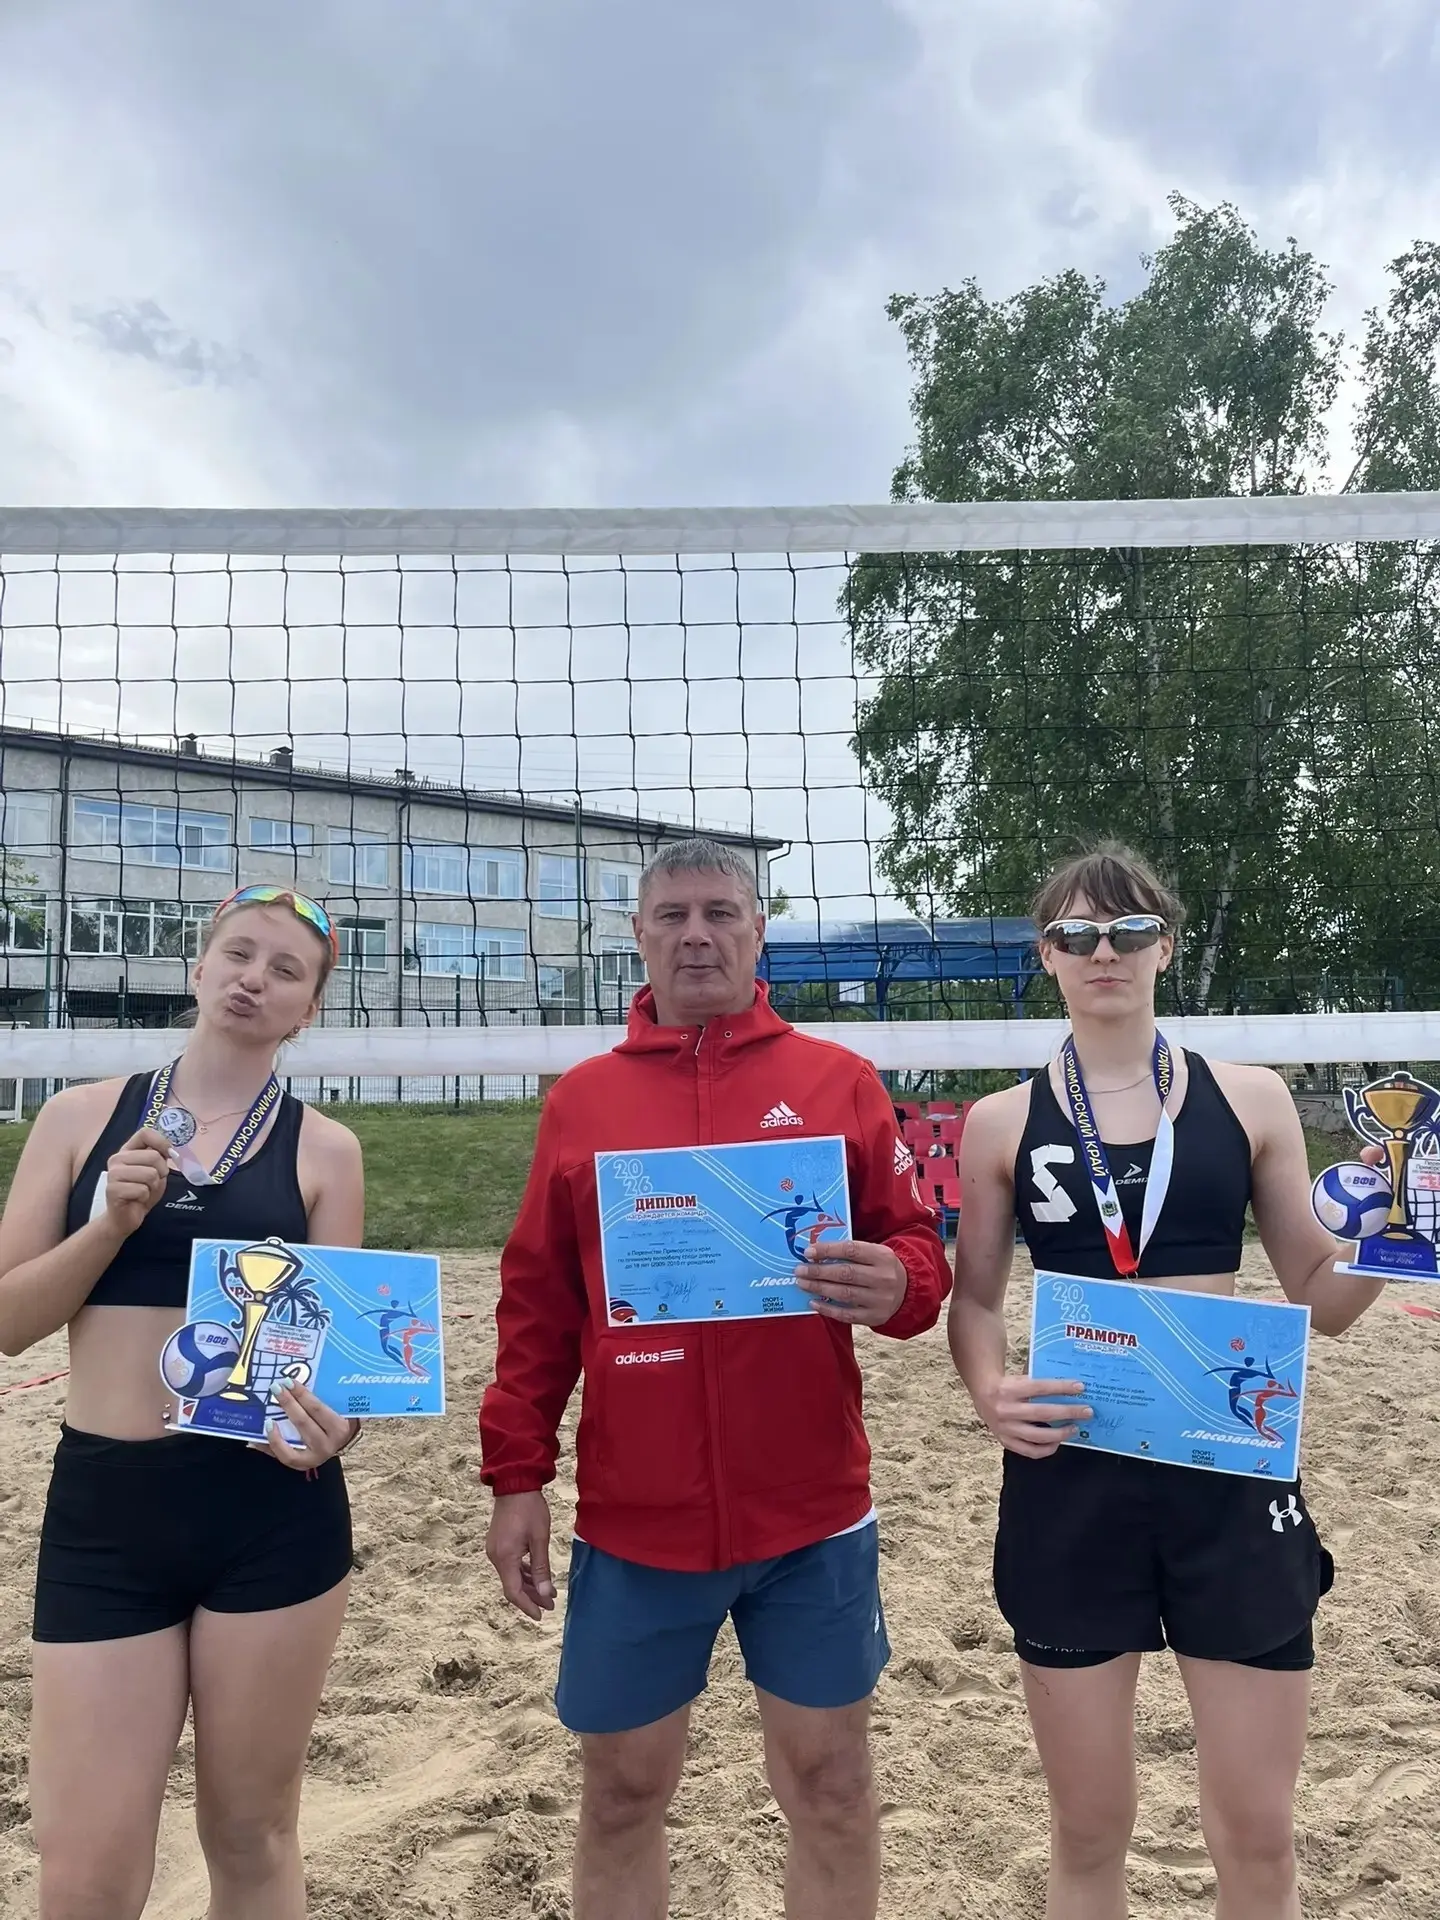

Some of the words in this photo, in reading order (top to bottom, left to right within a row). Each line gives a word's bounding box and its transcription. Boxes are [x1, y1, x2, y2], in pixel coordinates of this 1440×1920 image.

[1158, 1043, 1170, 1101] ПРИМОР
[227, 1081, 279, 1160] ПРИМОРСКИЙ
[759, 1115, 804, 1129] adidas
[1065, 1051, 1098, 1138] ПРИМОРСКИЙ
[1084, 1140, 1110, 1177] КРАЙ
[613, 1159, 644, 1179] 20
[623, 1176, 654, 1196] 26
[1115, 1177, 1149, 1186] DEMI
[1352, 1176, 1377, 1186] ВФВ
[164, 1202, 205, 1212] DEMIX
[635, 1195, 697, 1213] ДИПЛОМ
[1052, 1281, 1085, 1305] 20
[1060, 1303, 1092, 1323] 26
[205, 1334, 229, 1346] ВФВ
[1066, 1324, 1138, 1347] ГРАМОТА
[615, 1351, 660, 1365] adidas
[338, 1373, 432, 1385] г.Лесозаводск
[1180, 1429, 1286, 1449] г.Лесозаводск
